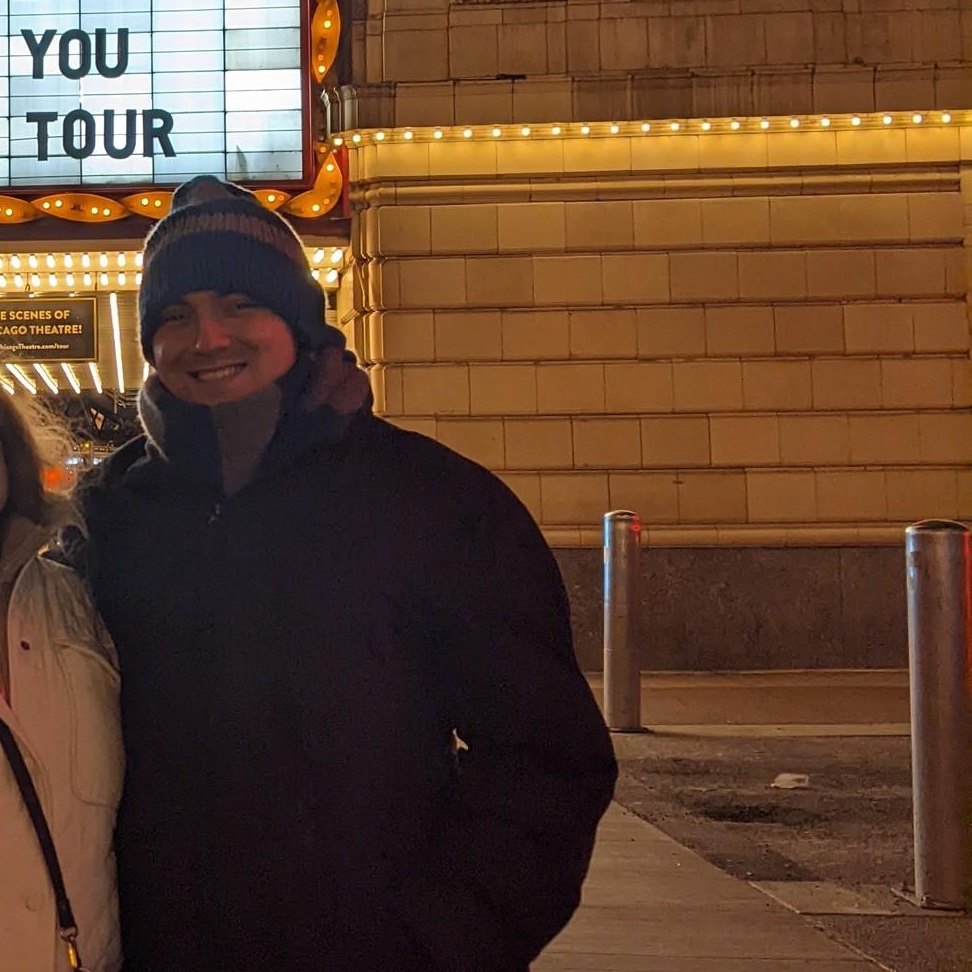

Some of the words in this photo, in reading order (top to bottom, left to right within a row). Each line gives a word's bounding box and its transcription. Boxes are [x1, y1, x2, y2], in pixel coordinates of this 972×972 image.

[21, 28, 128, 79] YOU
[26, 108, 177, 161] TOUR
[9, 310, 51, 320] SCENES
[53, 309, 71, 320] OF
[29, 324, 83, 336] THEATRE!
